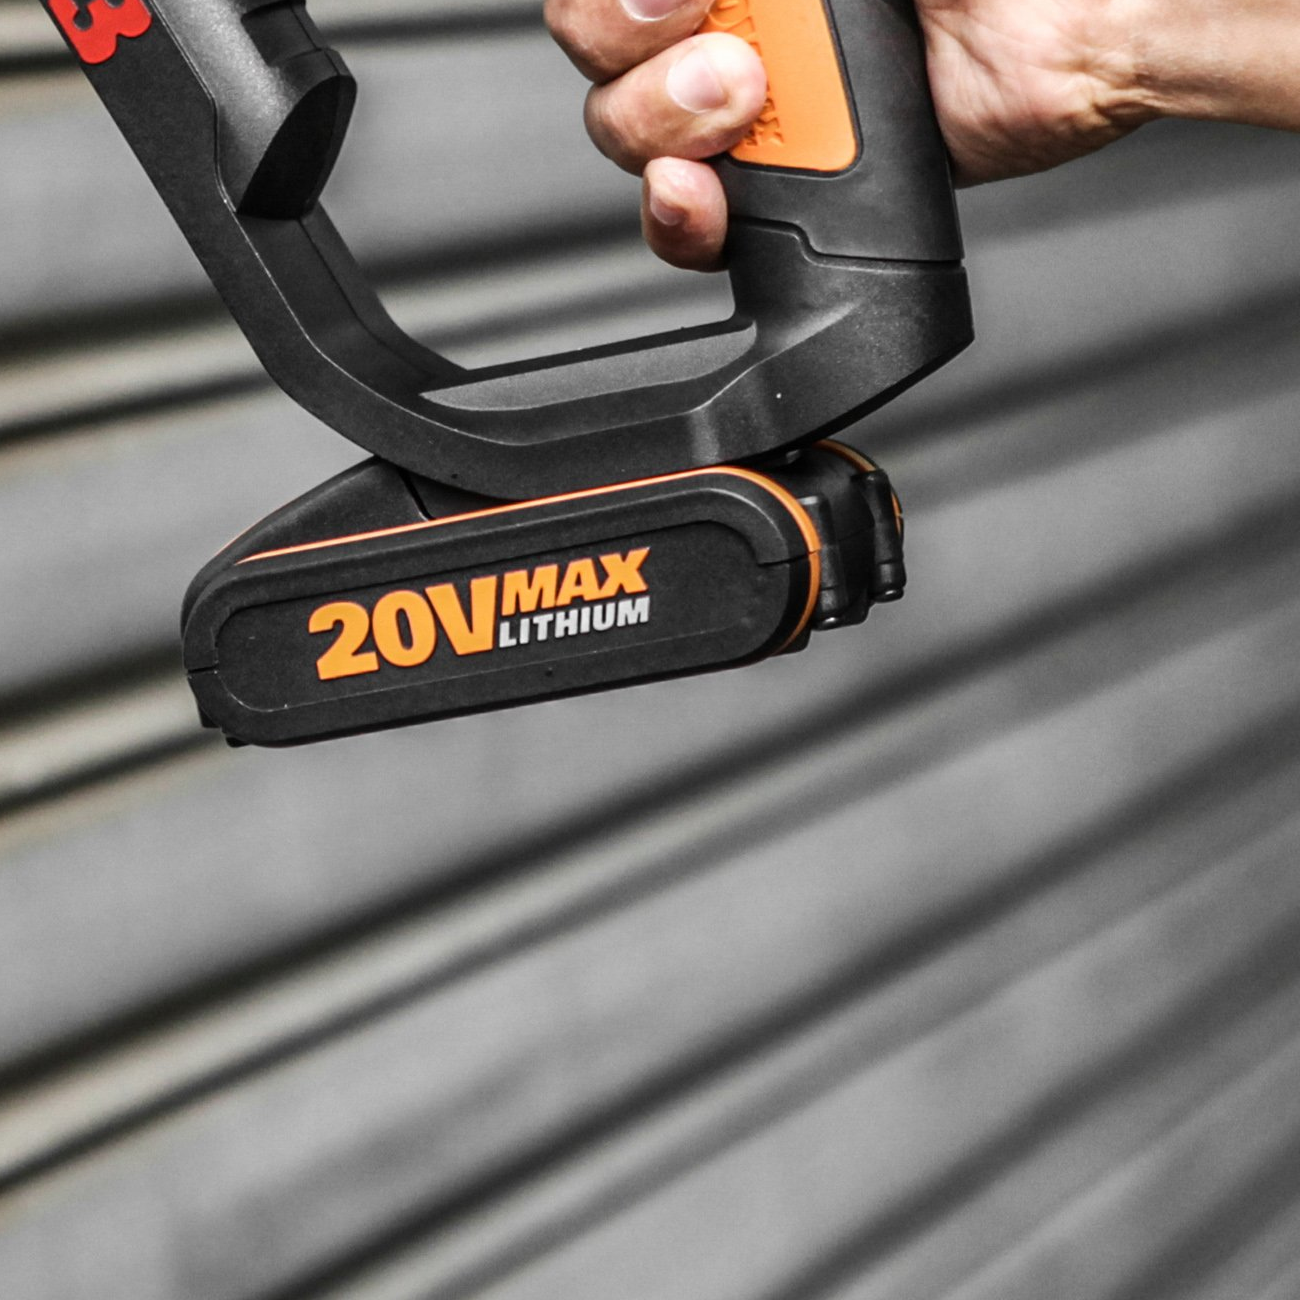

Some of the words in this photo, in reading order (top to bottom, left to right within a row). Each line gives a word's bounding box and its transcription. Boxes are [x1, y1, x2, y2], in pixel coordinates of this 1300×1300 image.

[308, 575, 497, 681] 20V
[501, 547, 650, 616] MAX
[499, 596, 650, 648] LITHIUM
